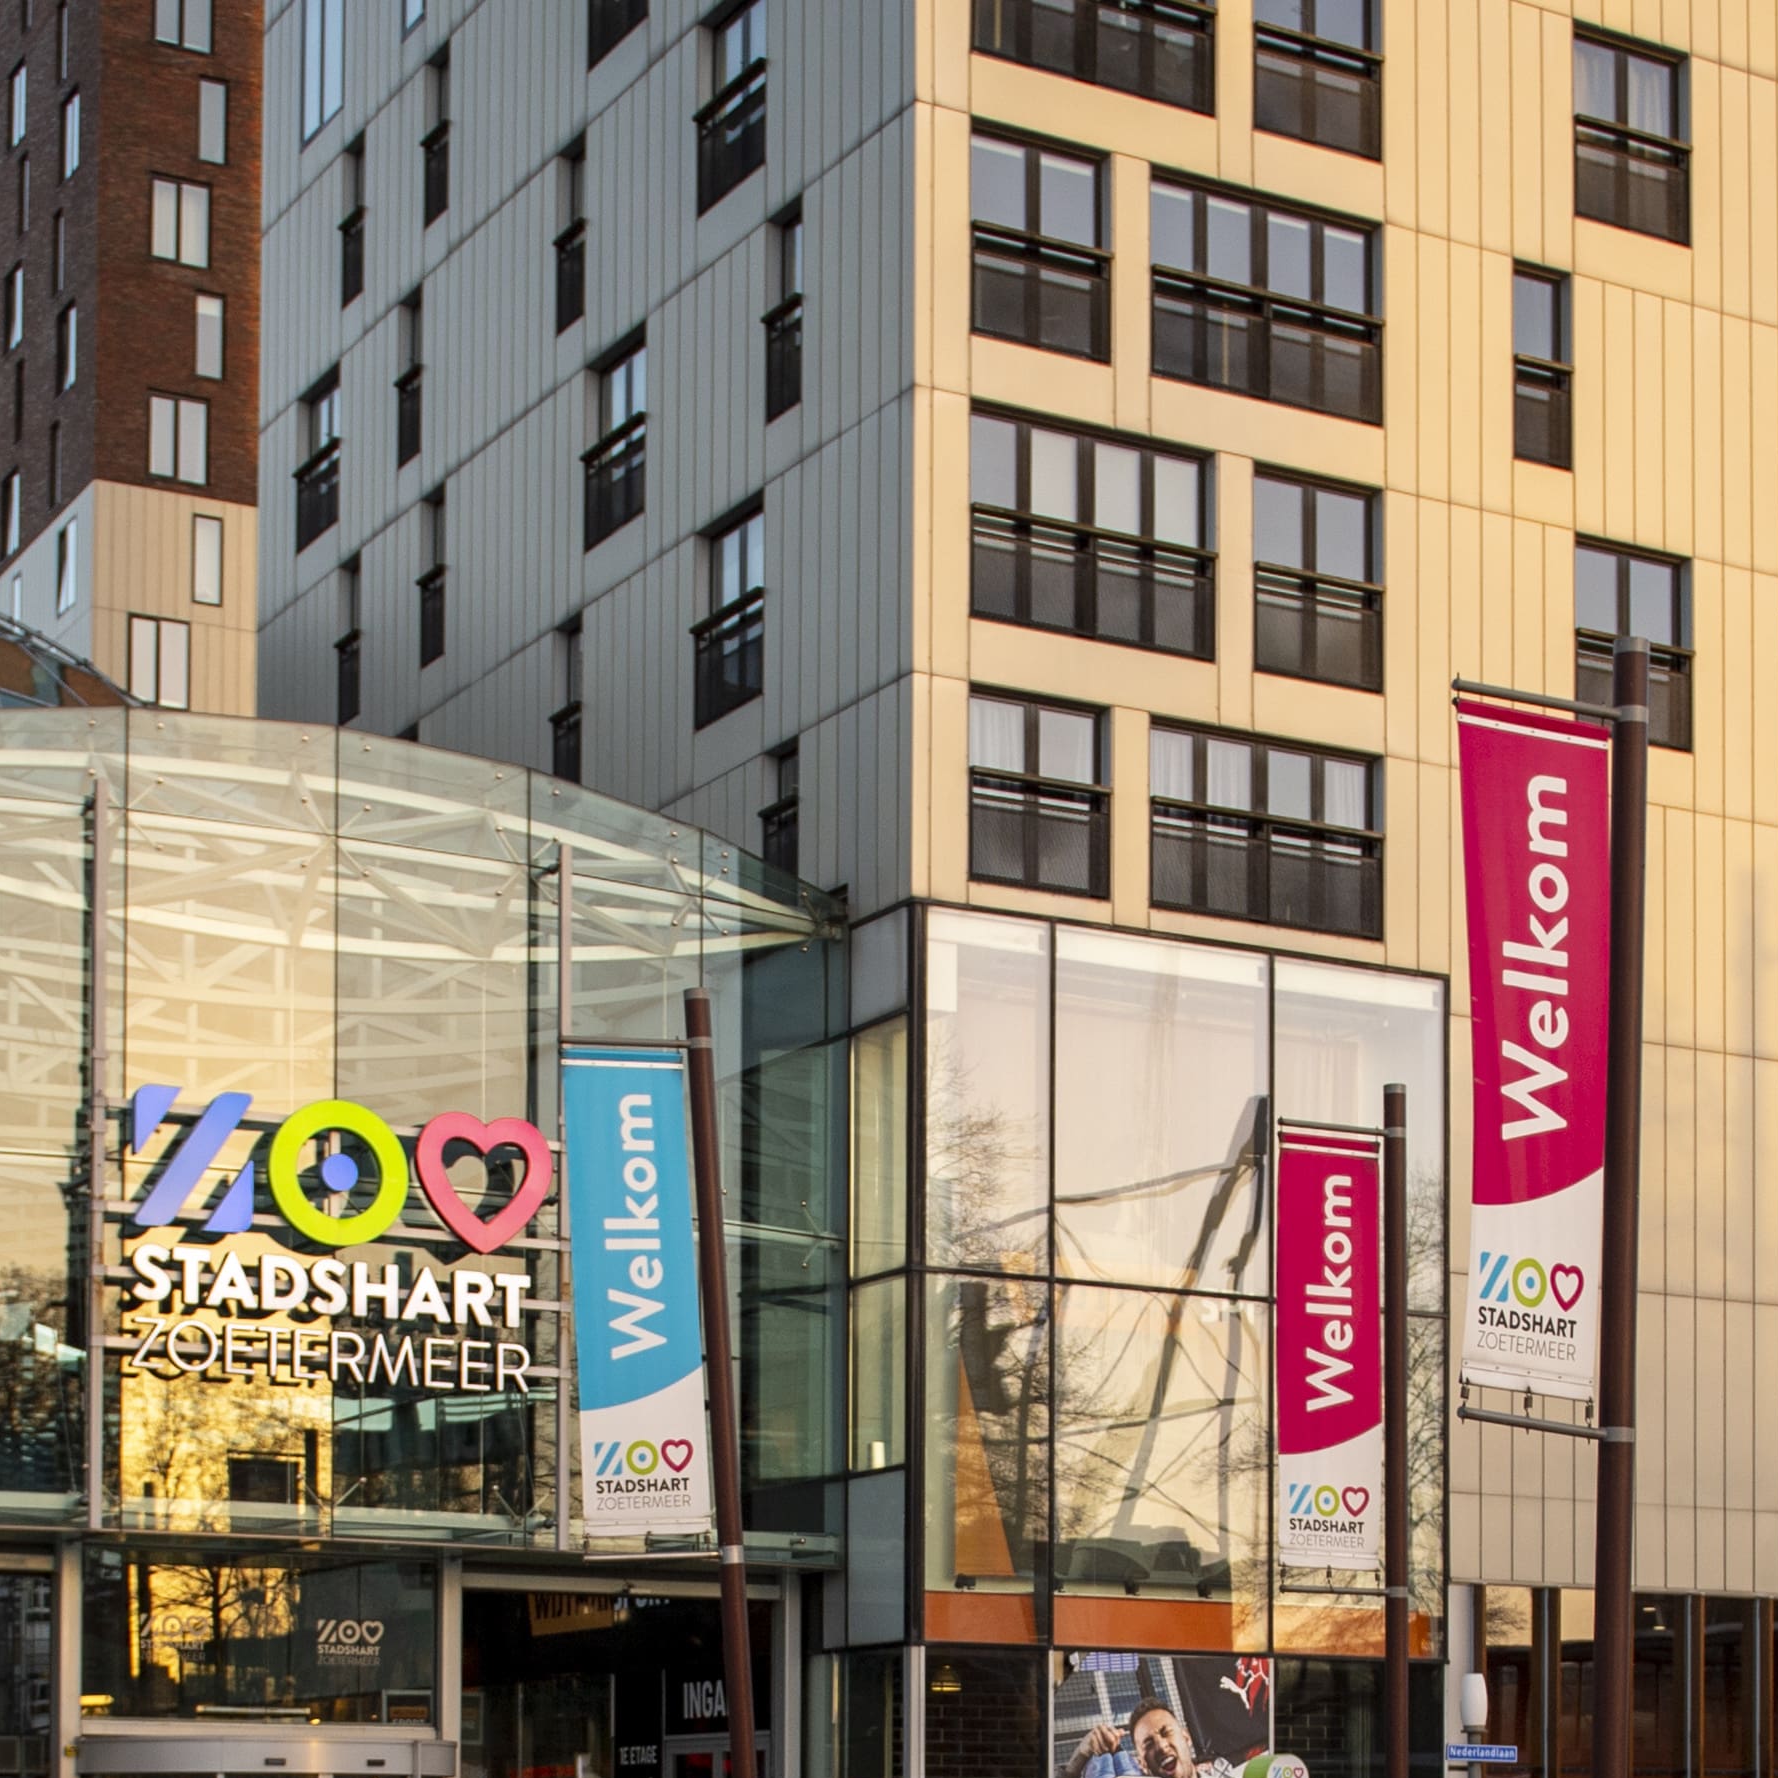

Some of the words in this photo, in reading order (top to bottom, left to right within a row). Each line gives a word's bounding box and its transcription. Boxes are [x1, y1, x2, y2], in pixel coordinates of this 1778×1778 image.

[1501, 774, 1570, 1141] Welkom
[603, 1094, 667, 1361] Welkom
[132, 1244, 532, 1328] STADSHART
[1305, 1174, 1354, 1412] Welkom
[1478, 1306, 1577, 1338] STADSHART
[131, 1316, 531, 1393] ZOETERMEER
[1477, 1330, 1576, 1362] ZOETERMEER
[596, 1477, 689, 1494] STADSHART
[596, 1494, 692, 1511] ZOETERMEER
[1289, 1518, 1365, 1534] STADSHART
[1289, 1533, 1365, 1549] ZOETERMEER
[318, 1645, 381, 1656] STADSHART
[683, 1679, 729, 1719] INGA
[1450, 1746, 1515, 1758] Nederlandlaan
